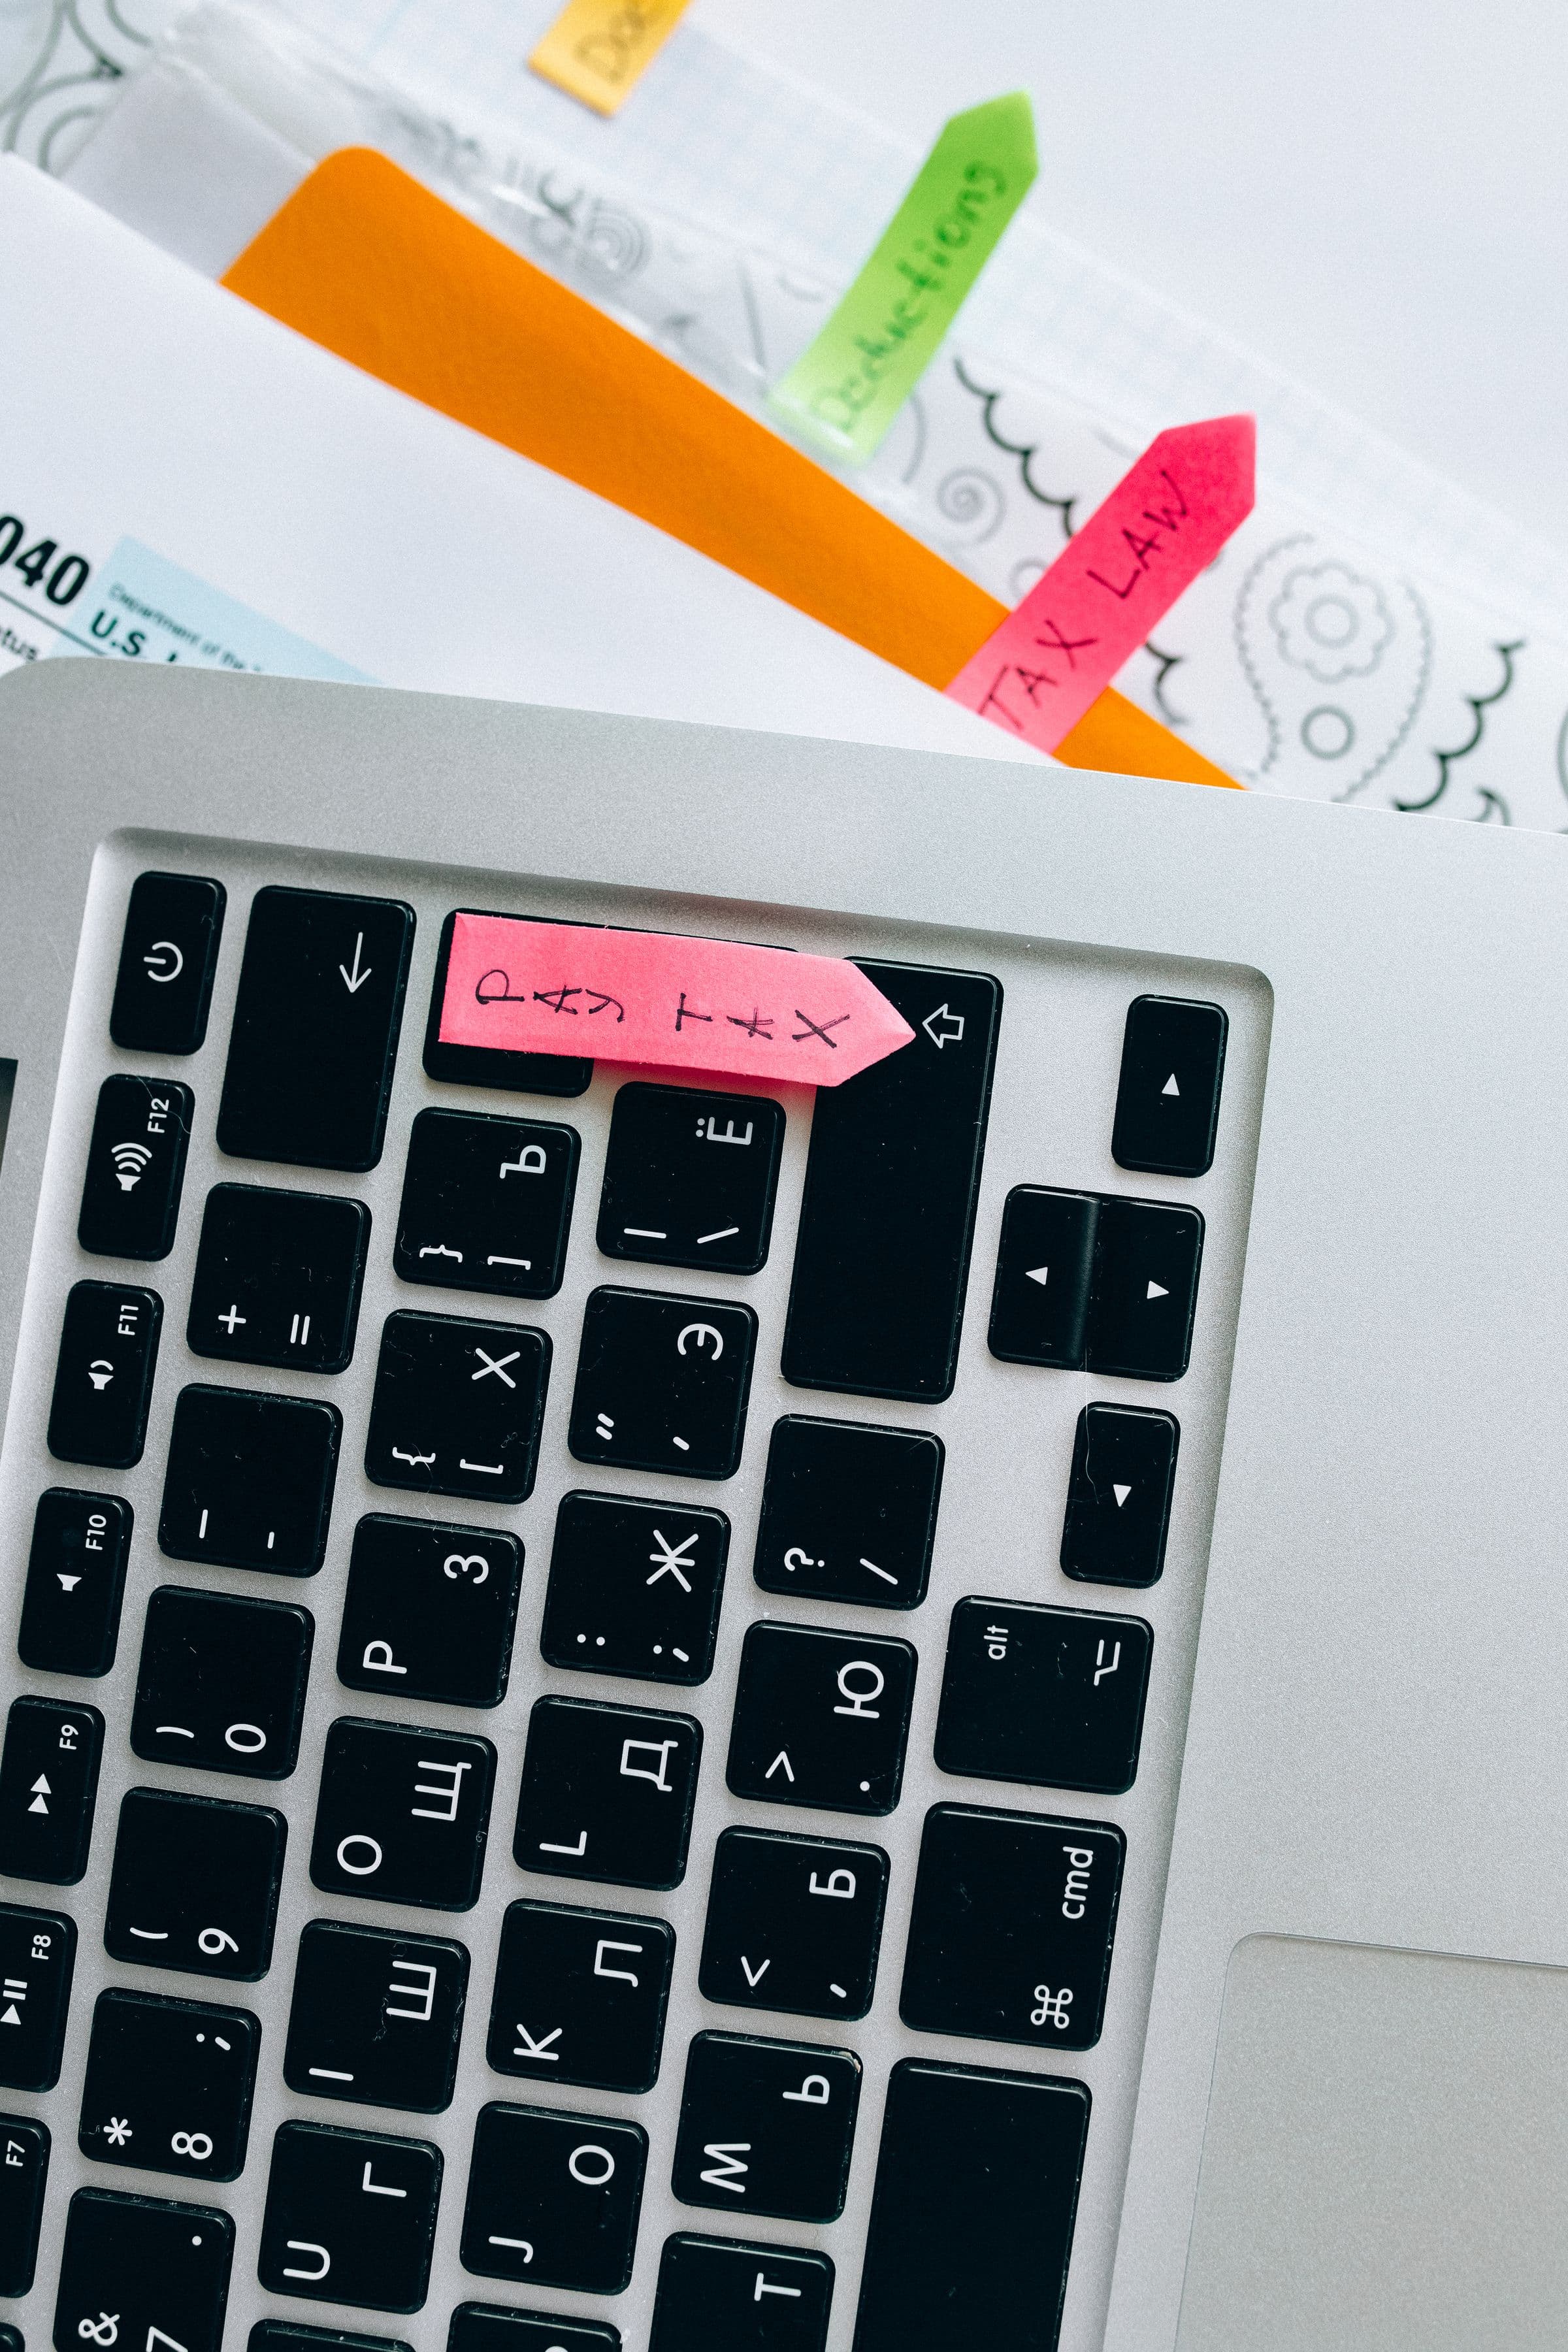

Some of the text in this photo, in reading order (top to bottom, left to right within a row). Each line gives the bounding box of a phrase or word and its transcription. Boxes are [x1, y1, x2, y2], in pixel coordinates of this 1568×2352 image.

[811, 160, 1009, 432] Deductions
[108, 582, 201, 644] Department
[979, 470, 1187, 731] TAX LAW
[676, 992, 850, 1048] TAX
[147, 1098, 169, 1134] F12
[695, 1117, 753, 1145] Ё
[499, 1145, 547, 1179] Ъ
[118, 1305, 139, 1335] F11
[677, 1323, 723, 1361] Э
[471, 1348, 521, 1388] Х
[85, 1514, 106, 1550] F10
[444, 1554, 489, 1584] З
[646, 1529, 699, 1593] Ж
[363, 1640, 408, 1674] P
[983, 1625, 1009, 1660] alt
[833, 1661, 885, 1719] Ю
[59, 1724, 79, 1750] F9
[619, 1739, 679, 1792] Д
[411, 1761, 472, 1821] Щ
[336, 1835, 382, 1875] O
[539, 1831, 587, 1856] L
[809, 1869, 857, 1899] Б
[1062, 1846, 1094, 1919] cmd
[31, 1935, 52, 1960] F8
[198, 1928, 239, 1955] 9
[593, 1940, 643, 1987] Л
[385, 1961, 437, 2021] Ш
[513, 2023, 563, 2061] K
[782, 2074, 830, 2104] Ь
[5, 2140, 25, 2166] F7
[171, 2131, 213, 2160] 8
[362, 2161, 407, 2198] Г
[568, 2145, 615, 2185] О
[700, 2143, 751, 2193] M
[283, 2240, 331, 2280] U
[488, 2236, 534, 2264] J
[754, 2272, 802, 2301] Т
[146, 2326, 188, 2352] 7
